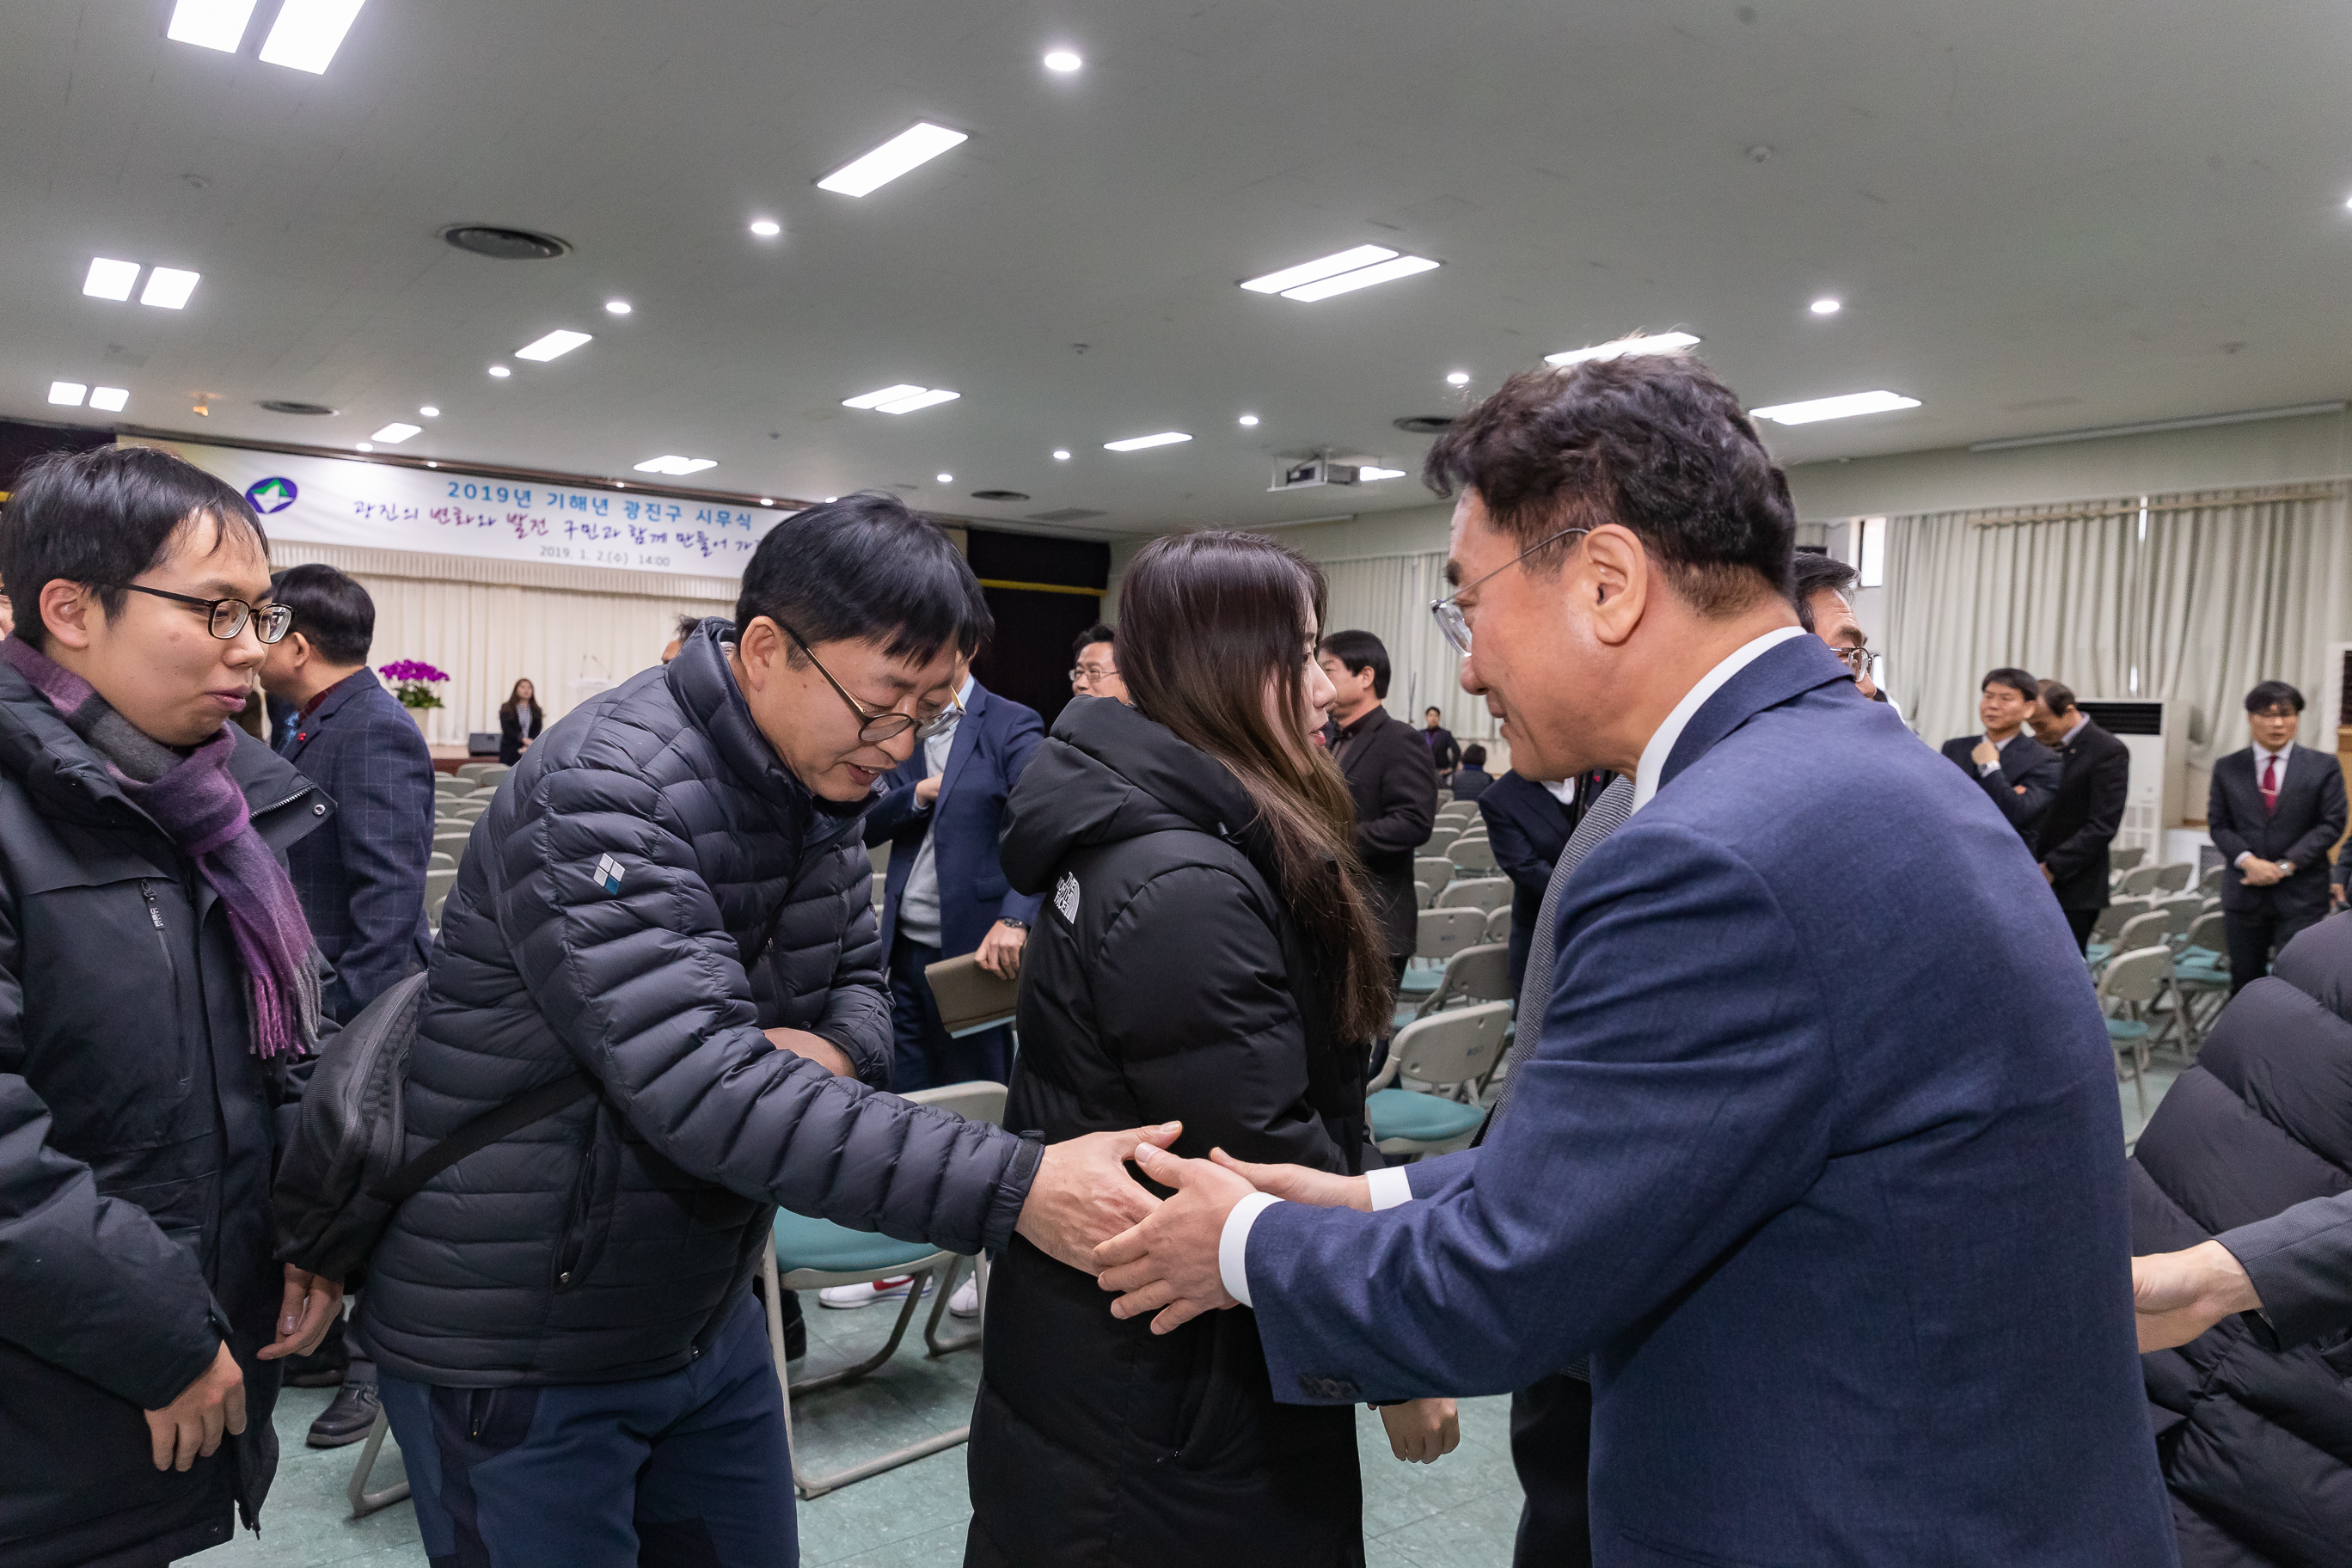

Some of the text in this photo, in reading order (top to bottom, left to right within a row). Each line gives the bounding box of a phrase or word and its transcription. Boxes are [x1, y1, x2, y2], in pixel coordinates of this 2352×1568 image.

[354, 501, 419, 521] 광진의
[430, 506, 497, 526] 변화와
[506, 512, 548, 540] 발전
[564, 519, 621, 541] 구민과
[628, 524, 667, 545] 함께
[676, 530, 727, 558] 만들어
[448, 481, 751, 531] 2019년 기해년 광진구 시무식
